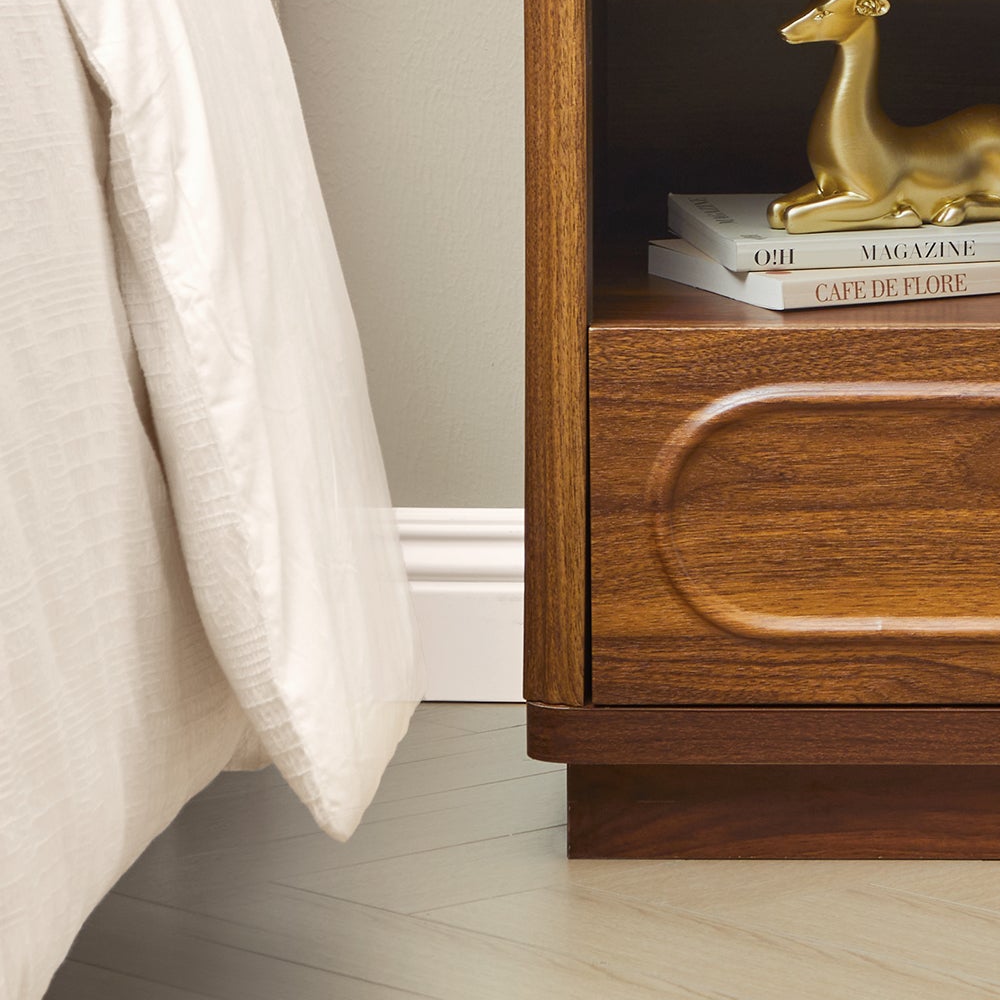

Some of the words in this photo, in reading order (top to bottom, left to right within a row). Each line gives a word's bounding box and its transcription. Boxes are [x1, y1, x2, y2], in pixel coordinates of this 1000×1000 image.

[754, 248, 795, 267] O!H
[860, 240, 976, 262] MAGAZINE
[815, 280, 866, 303] CAFE
[872, 278, 898, 298] DE
[903, 273, 968, 296] FLORE
